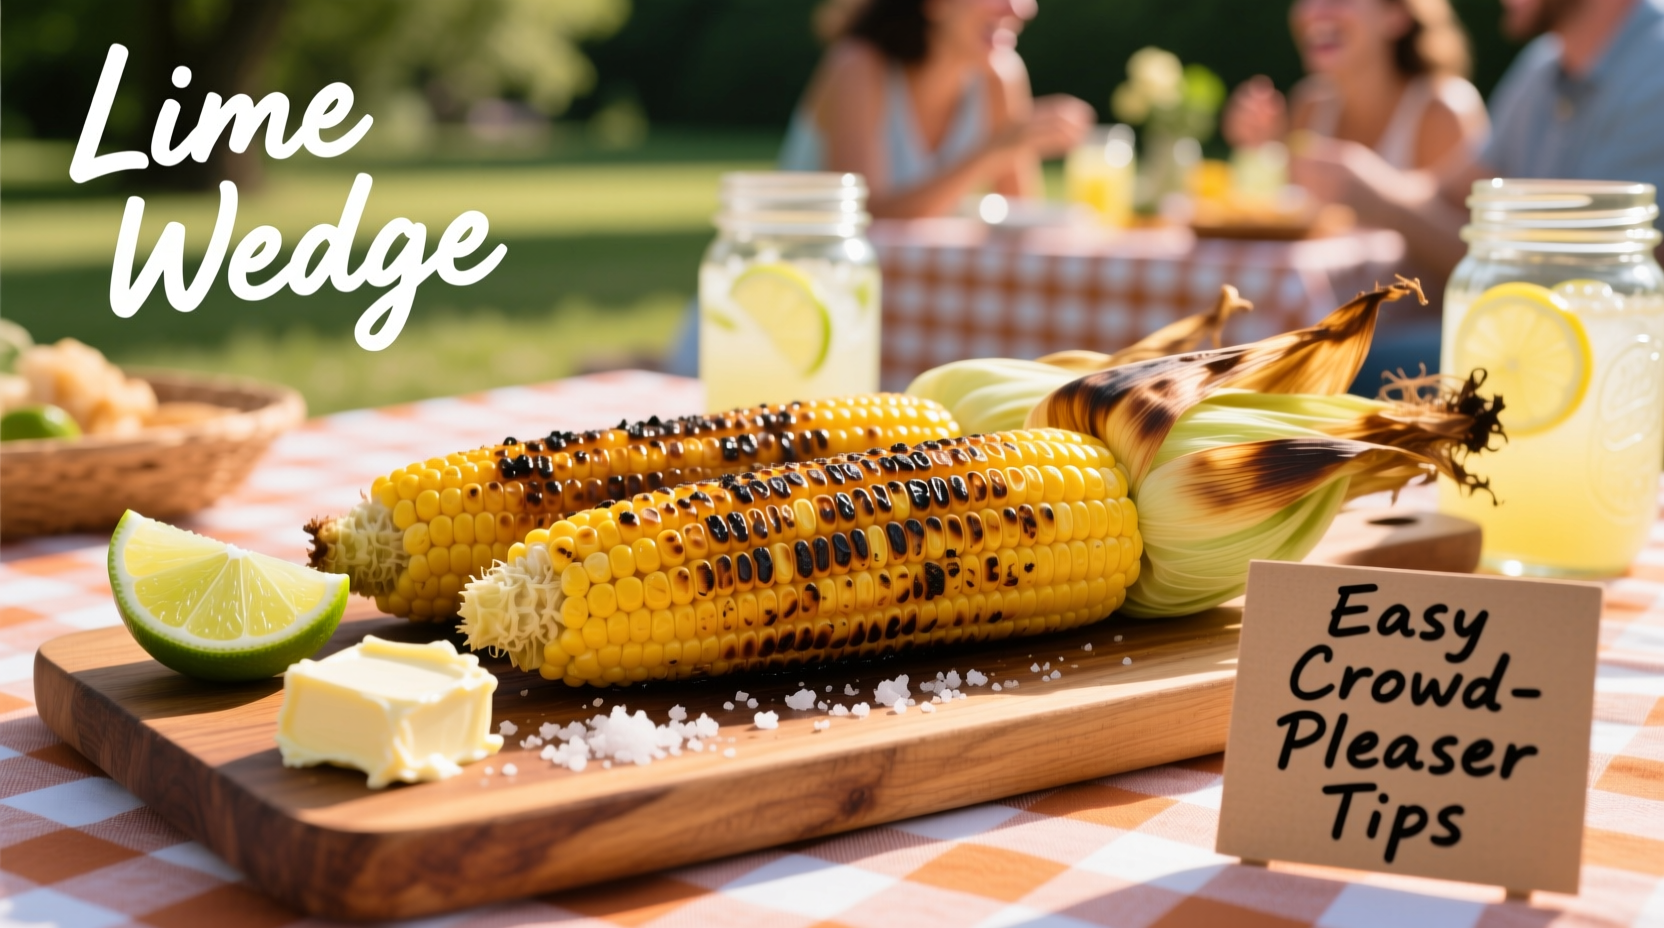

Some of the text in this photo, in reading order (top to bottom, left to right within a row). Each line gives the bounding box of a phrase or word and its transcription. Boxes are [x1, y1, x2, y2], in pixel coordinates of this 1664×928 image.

[1327, 583, 1489, 664] Easy
[1289, 644, 1542, 713] Crowd-
[1276, 709, 1539, 780] Pleaser
[1321, 782, 1465, 864] Tips
